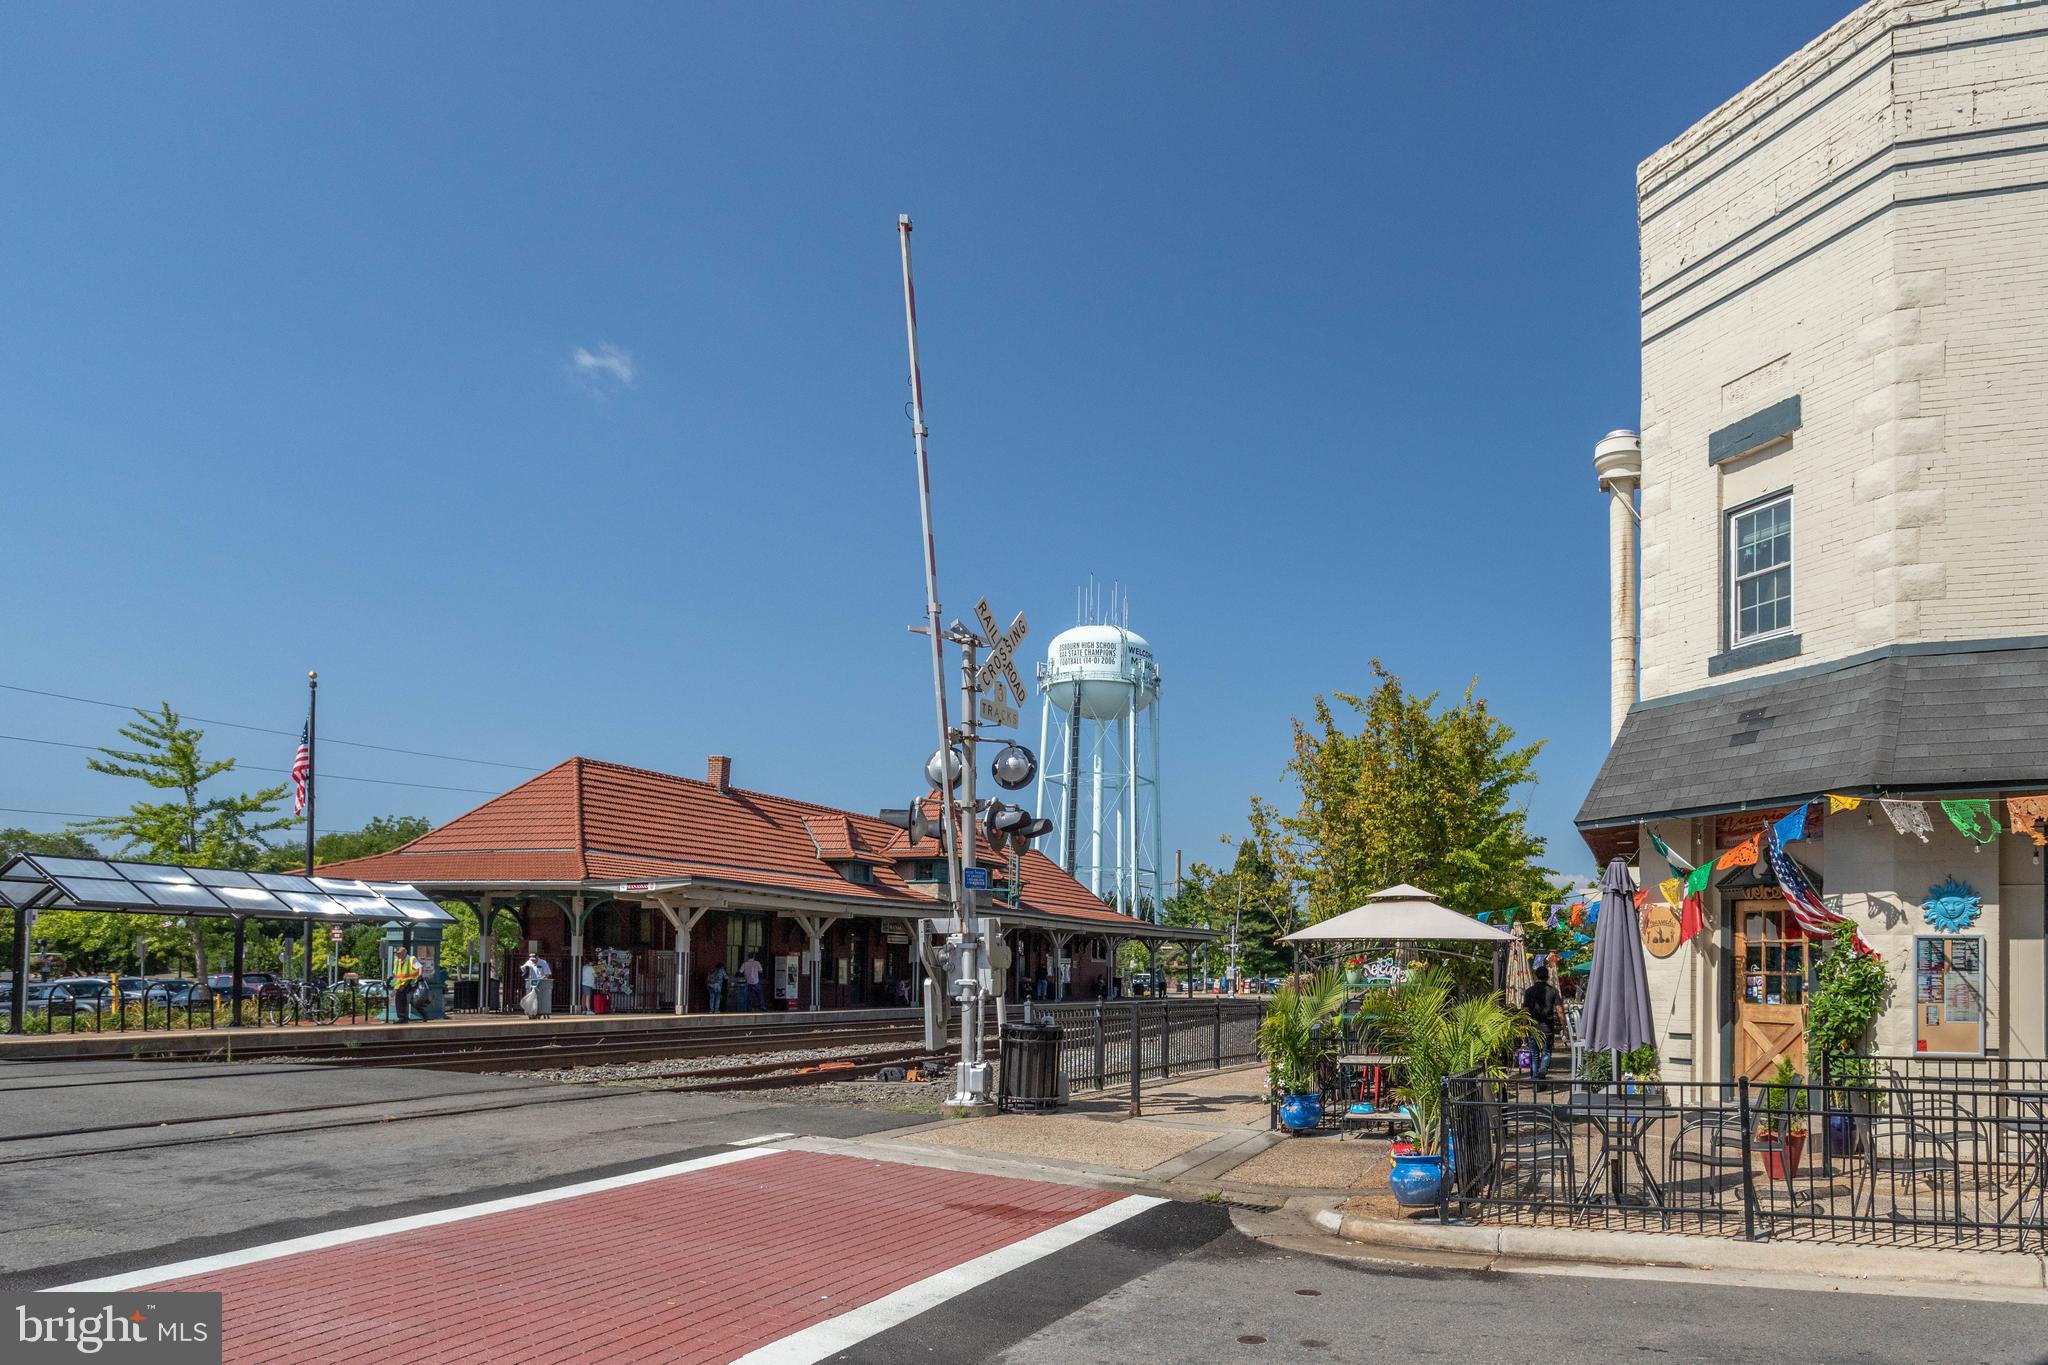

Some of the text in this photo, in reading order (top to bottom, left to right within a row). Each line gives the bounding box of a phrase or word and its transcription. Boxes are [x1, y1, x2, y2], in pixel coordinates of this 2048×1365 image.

[978, 601, 998, 644] RAIL
[982, 620, 1026, 686] CROSSING
[1068, 649, 1082, 657] STATE
[1084, 649, 1116, 657] CHAMPIONS
[1095, 641, 1117, 650] SCHOOL
[1101, 657, 1116, 665] 2006
[1005, 661, 1026, 702] ROAD
[981, 702, 1018, 722] TRACKS
